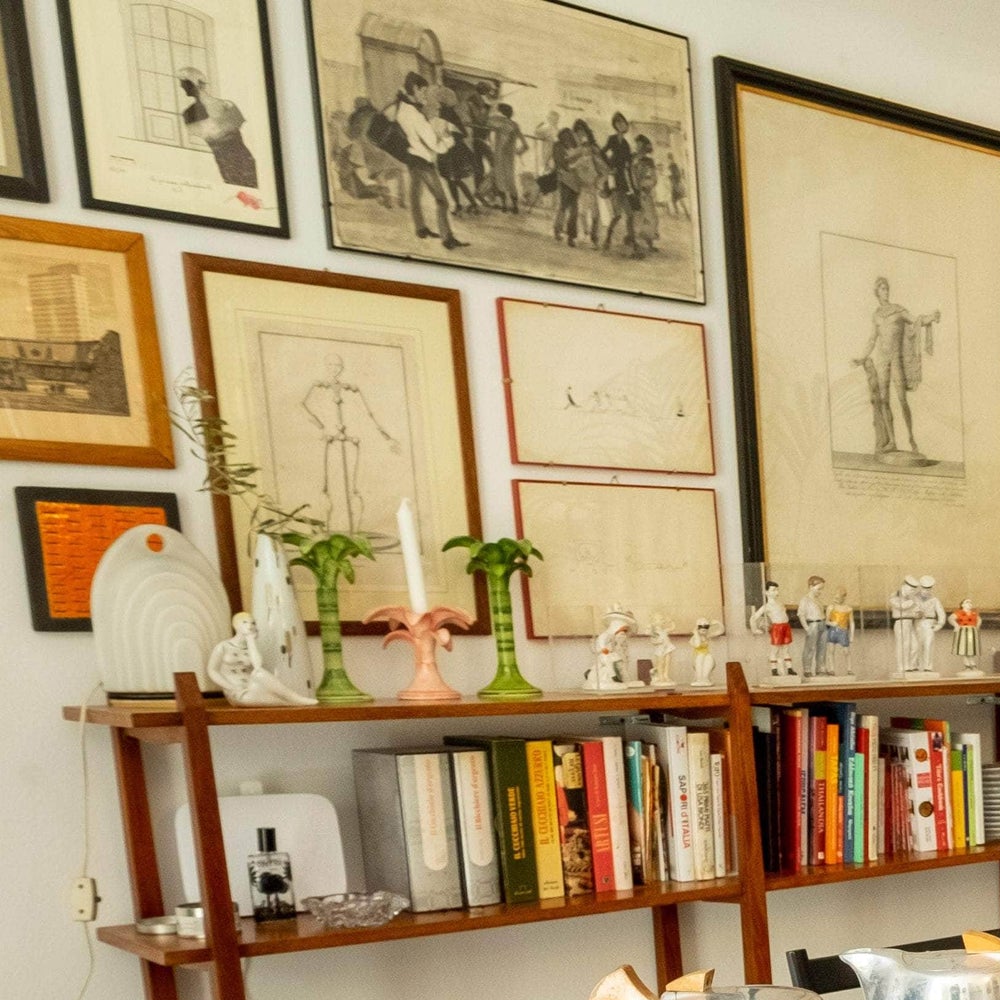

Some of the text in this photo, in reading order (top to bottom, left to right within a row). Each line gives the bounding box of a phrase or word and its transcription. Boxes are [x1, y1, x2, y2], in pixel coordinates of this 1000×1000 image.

[532, 749, 545, 788] AZZURRO
[509, 810, 520, 851] CUCCHIAIO
[536, 792, 548, 835] CUCCHIAIO
